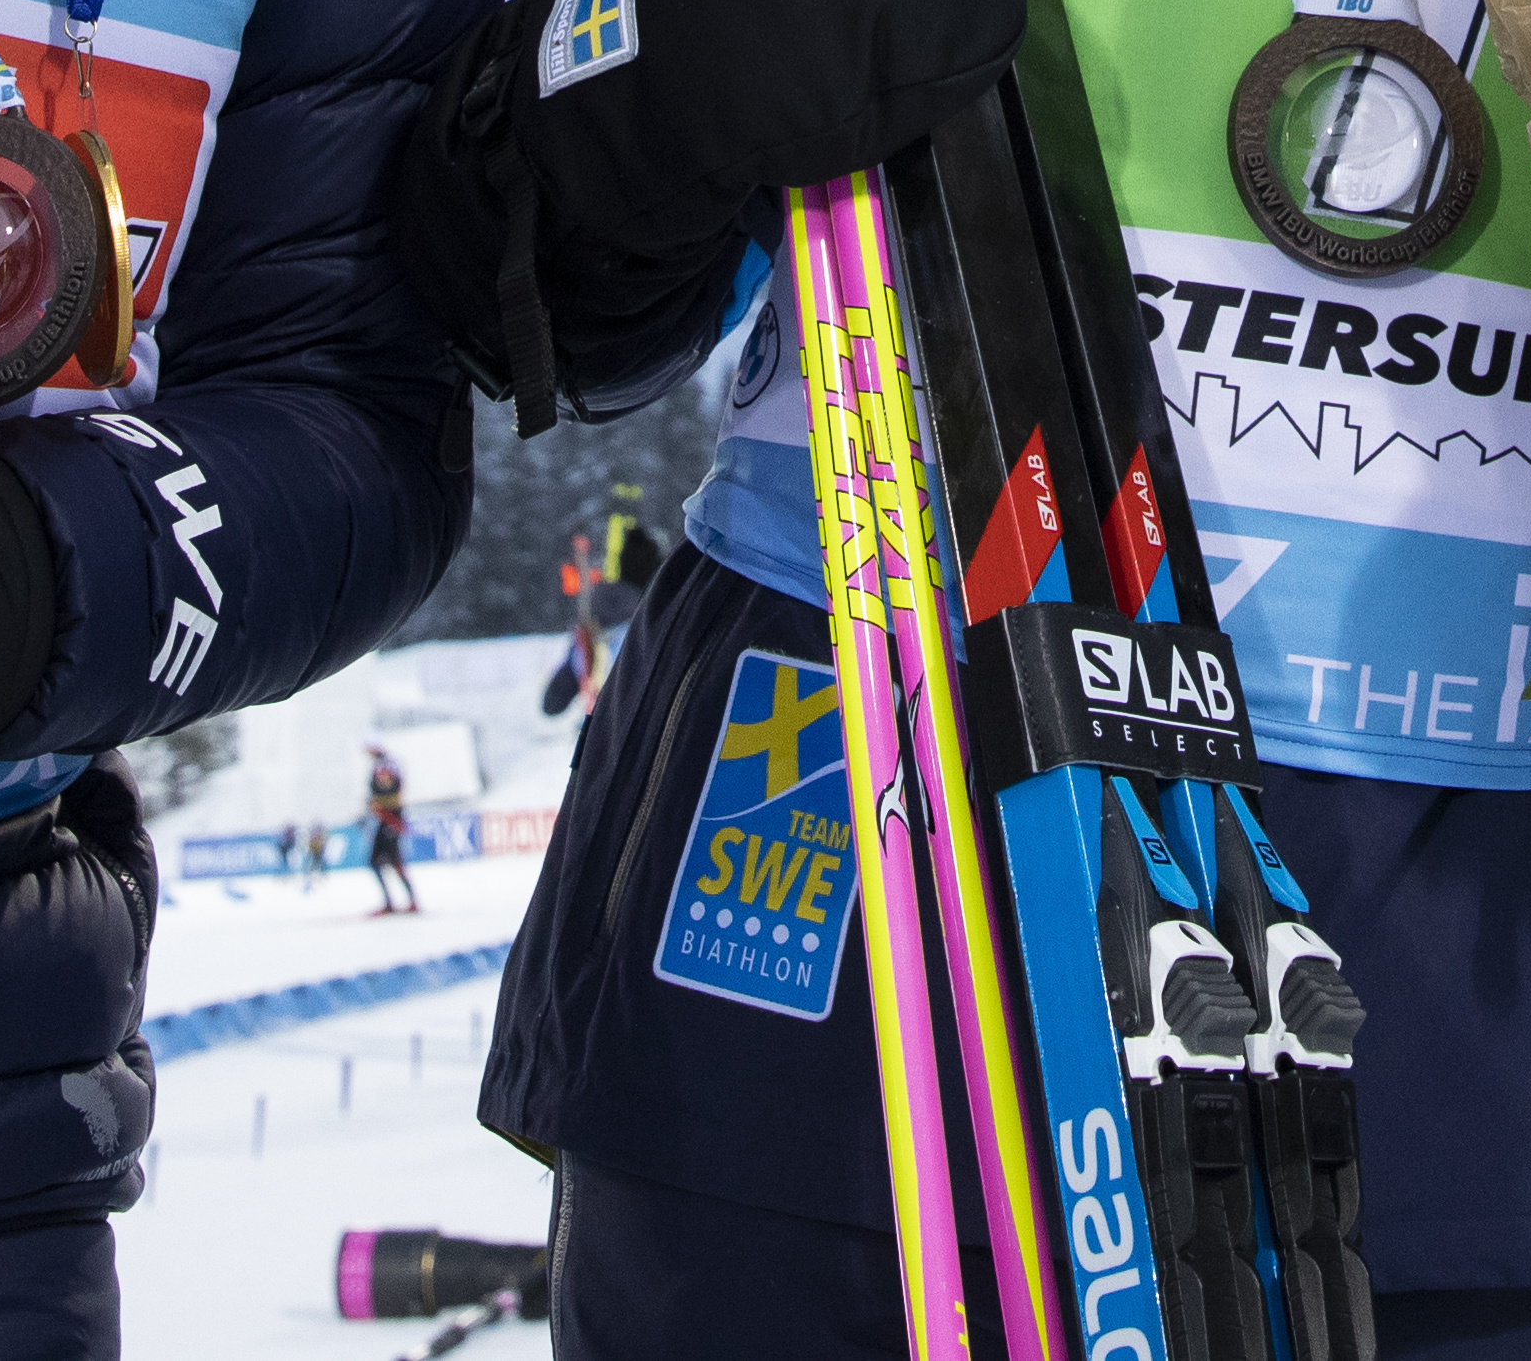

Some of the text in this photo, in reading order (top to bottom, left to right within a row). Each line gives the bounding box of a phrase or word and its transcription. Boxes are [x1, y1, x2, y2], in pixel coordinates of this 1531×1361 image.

[1286, 652, 1479, 742] THE
[1093, 720, 1242, 760] SELECT
[789, 808, 851, 852] TEAM
[697, 826, 843, 925] SWE
[681, 928, 814, 988] BIATHLON
